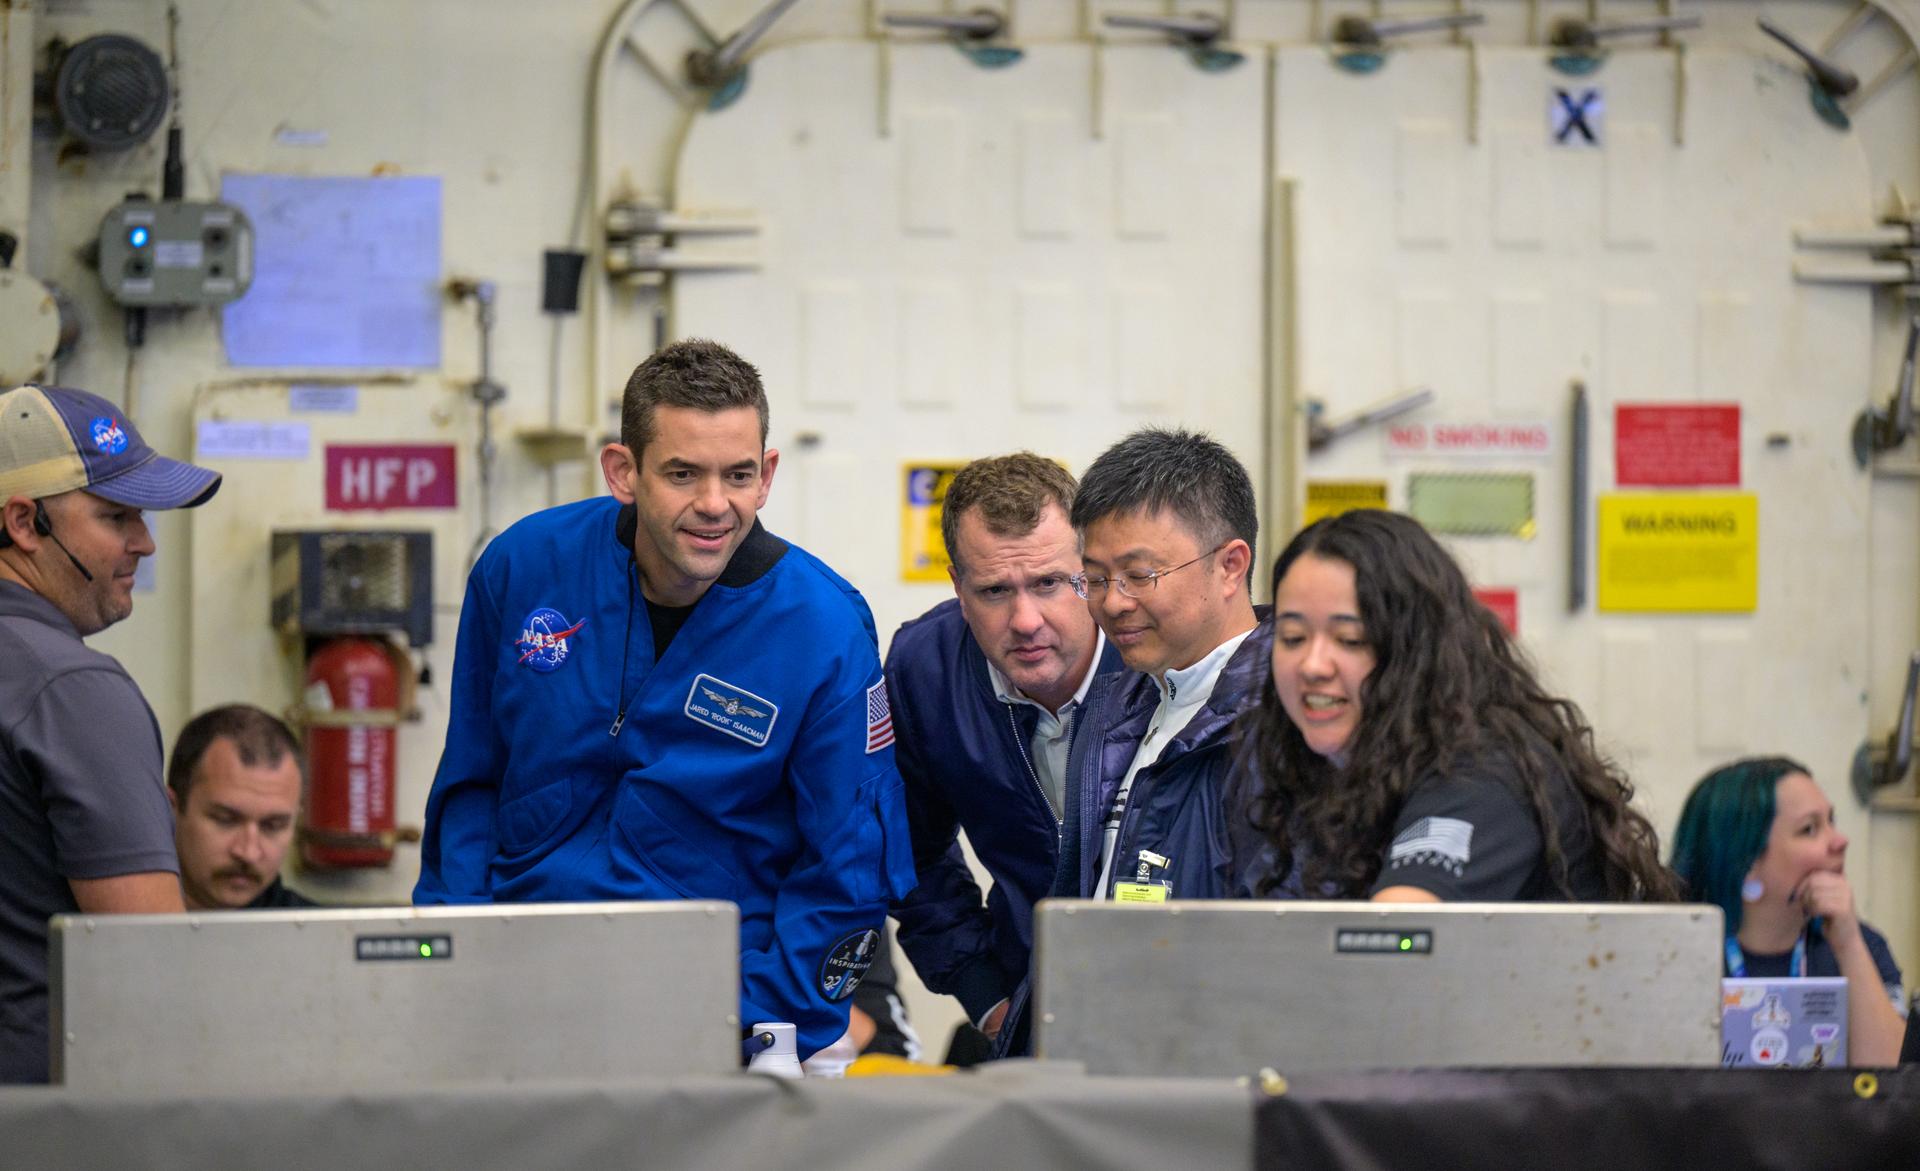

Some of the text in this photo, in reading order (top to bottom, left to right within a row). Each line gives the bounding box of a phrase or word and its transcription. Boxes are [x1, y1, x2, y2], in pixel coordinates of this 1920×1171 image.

[1554, 87, 1597, 144] X
[96, 427, 122, 446] NASA
[1390, 425, 1549, 448] NO SMOKING
[341, 457, 436, 502] HFP
[1622, 511, 1738, 536] WARNING
[522, 629, 568, 653] NASA
[689, 703, 709, 717] JARED
[733, 722, 765, 740] ISAACMAN
